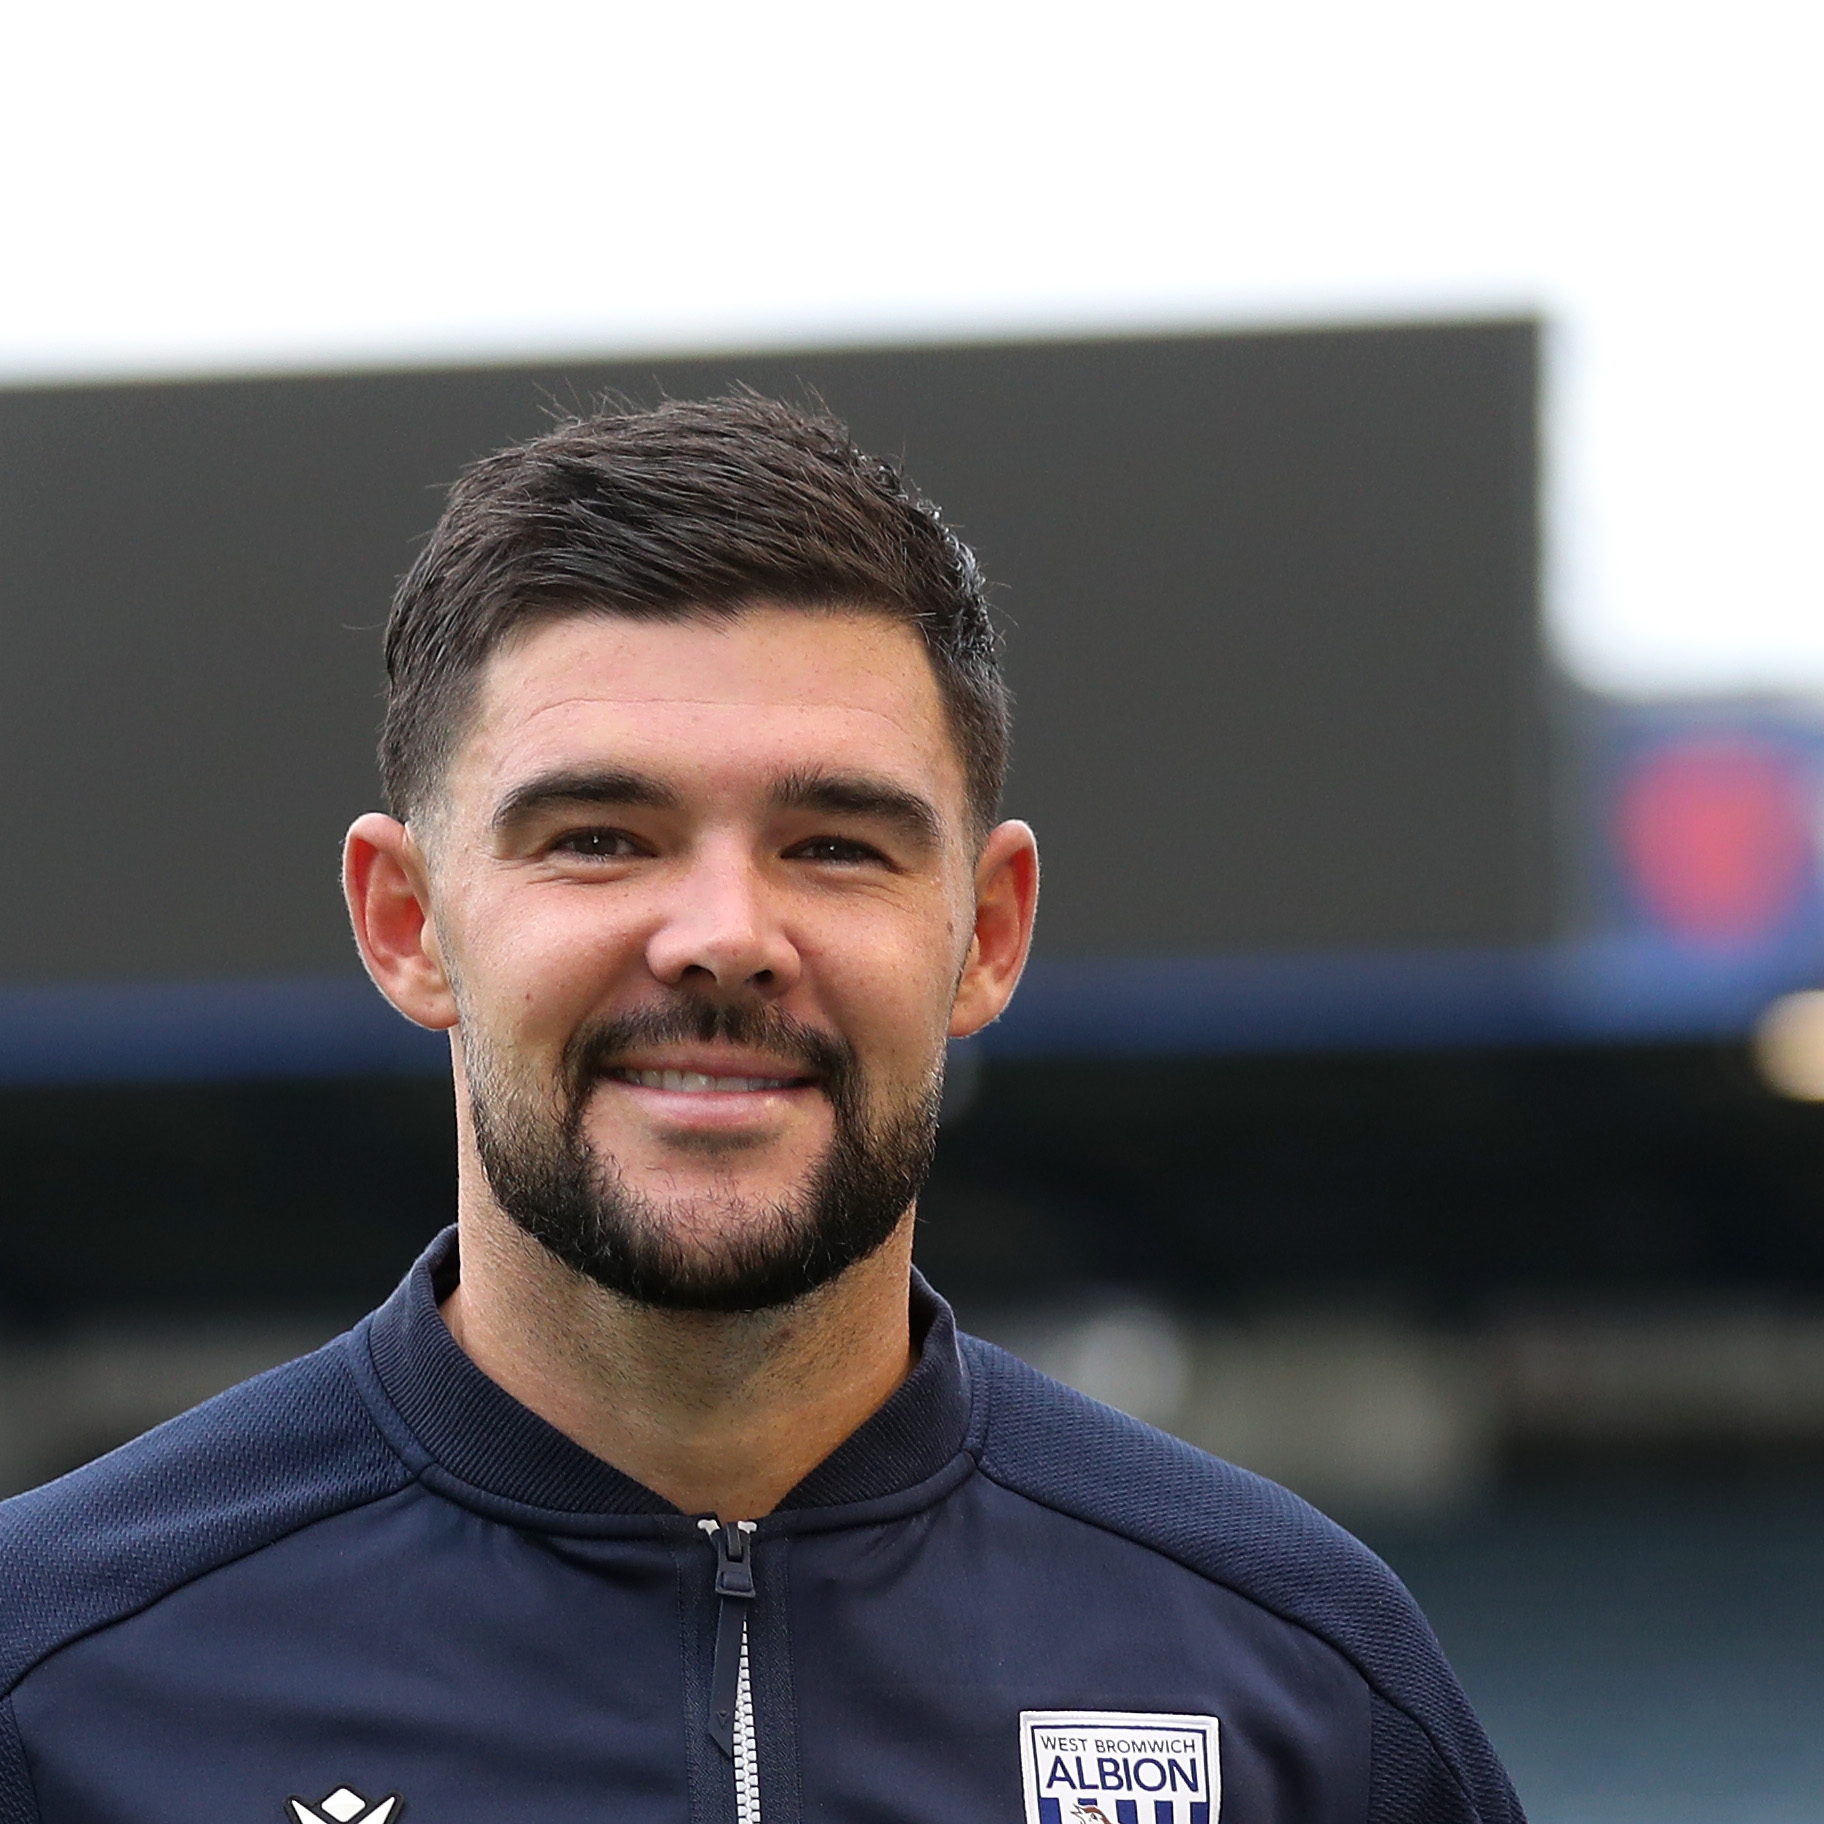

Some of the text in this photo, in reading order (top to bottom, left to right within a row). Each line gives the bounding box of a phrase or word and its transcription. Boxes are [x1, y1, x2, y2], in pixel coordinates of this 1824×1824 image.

[1040, 1735, 1196, 1754] WEST BROMWICH
[1045, 1755, 1199, 1793] ALBION
